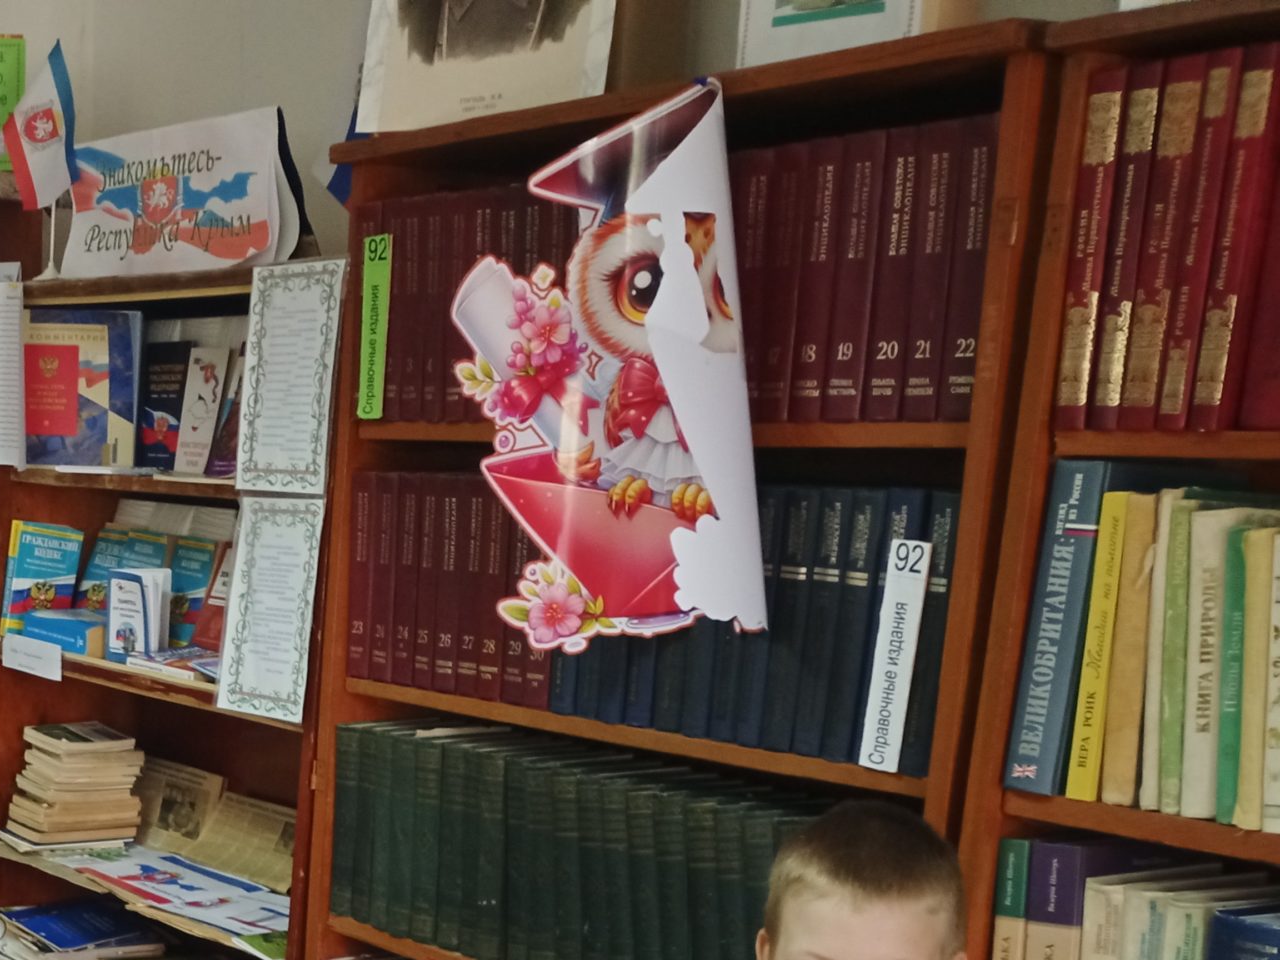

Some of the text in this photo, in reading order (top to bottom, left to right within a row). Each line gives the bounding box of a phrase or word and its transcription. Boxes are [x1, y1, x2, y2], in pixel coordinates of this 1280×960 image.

[888, 156, 905, 256] БОЛЬШАЯ СОВЕТСКАЯ
[190, 212, 253, 250] Крым
[368, 238, 387, 262] 92
[362, 284, 380, 415] Справочные издания
[836, 342, 853, 361] 19
[876, 340, 899, 360] 20
[914, 339, 931, 359] 21
[954, 338, 976, 358] 22
[894, 542, 924, 574] 92
[351, 621, 363, 634] 23
[397, 626, 409, 640] 24
[417, 630, 429, 643] 25
[439, 633, 452, 647] 26
[462, 636, 475, 650] 27
[482, 639, 496, 653] 28
[508, 641, 522, 655] 29
[1195, 566, 1218, 734] КНИГА ПРИРОДЫ
[868, 602, 909, 766] Справочные издания
[1083, 691, 1097, 727] РОИК
[1077, 736, 1090, 768] ВЕРА
